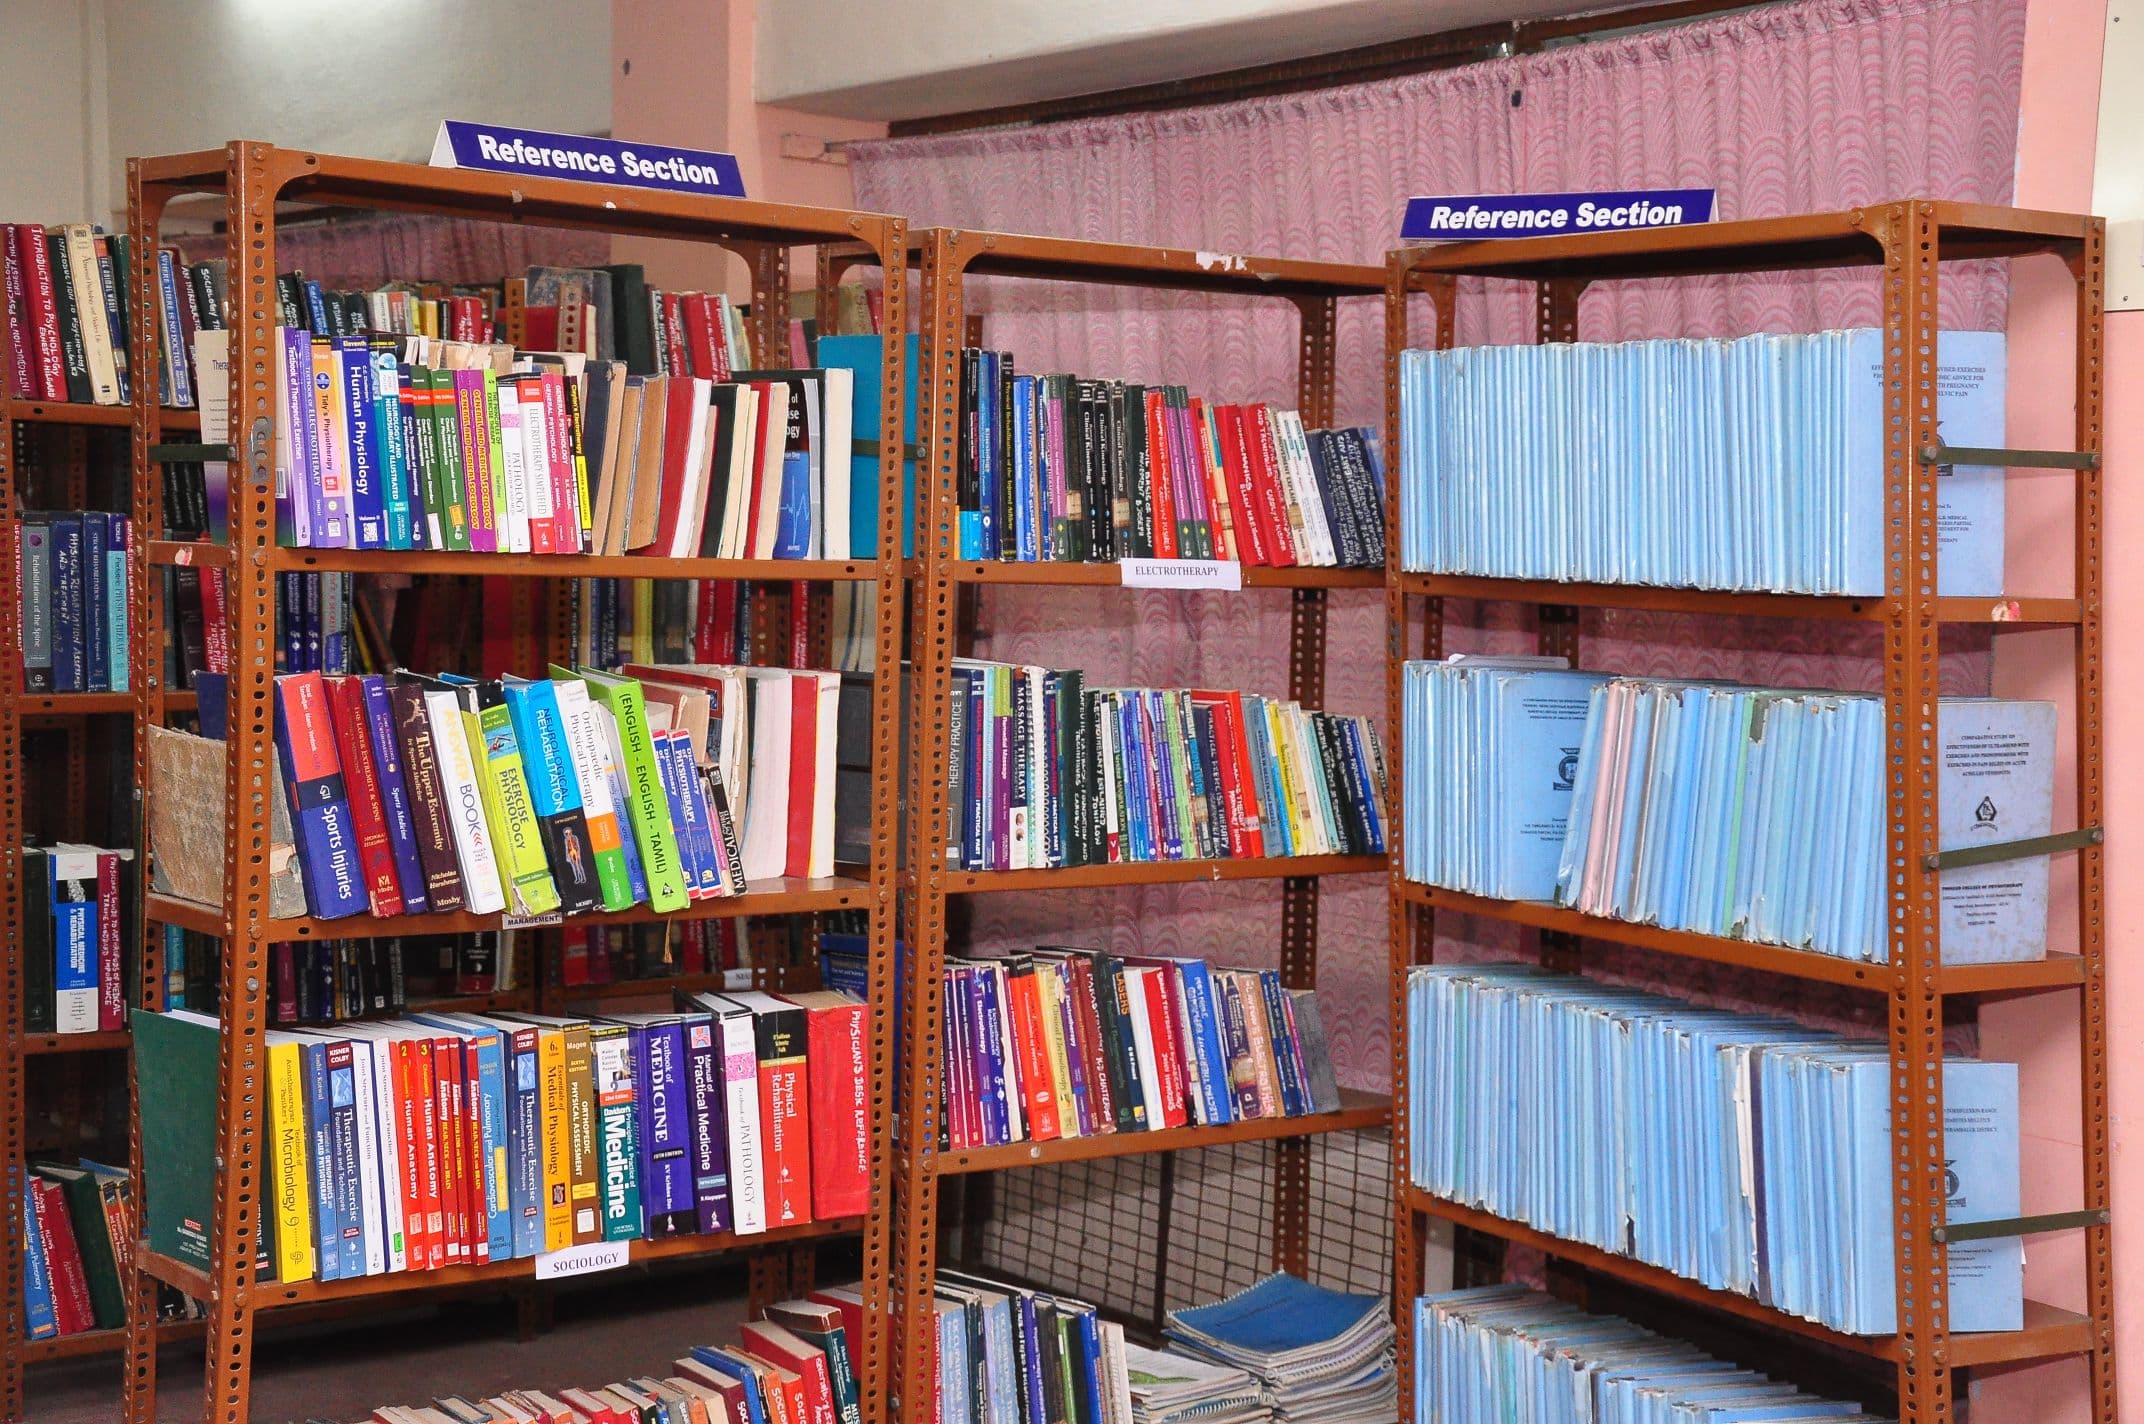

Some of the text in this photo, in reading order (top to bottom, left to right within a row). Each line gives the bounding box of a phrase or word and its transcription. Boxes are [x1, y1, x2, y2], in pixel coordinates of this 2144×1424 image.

[478, 134, 719, 185] Reference Section
[1429, 201, 1682, 229] Reference Section
[31, 228, 60, 376] INTRODUCTION TO PSYCHOLOGY
[58, 238, 75, 300] INTRODUCTION
[70, 304, 76, 313] TO
[160, 254, 181, 367] WHERE THERE DOCTOR
[288, 346, 303, 460] Textbook Therapeutic Exercises
[305, 367, 321, 486] TEXTBOOK ELECTROTHERAPY
[321, 395, 334, 470] Tidy's Physiotherapy
[350, 366, 368, 495] Human Physiology
[391, 398, 400, 441] NEUROLOGY
[555, 385, 569, 464] GENERAL PSYCHOLOGY
[385, 398, 399, 499] NEUROSURGERY ILLUSTRATED
[475, 389, 492, 529] GENERAL AND MEDICAL SOCIOLOGY
[529, 408, 547, 515] ELECTROTHERAPY SIMPLIFIED
[1084, 442, 1093, 484] Kinesiology
[1099, 442, 1107, 485] Kinesiology
[1117, 447, 1125, 492] Kinesiology
[512, 452, 525, 514] PATHOLOGY
[32, 555, 41, 606] Rehabilitation
[1135, 566, 1219, 576] ELECTROTHERAPY
[115, 588, 123, 622] PHYSICAL
[32, 628, 41, 647] Spine
[444, 710, 480, 833] ANSWER BOOK
[535, 709, 564, 812] REHABILITATION
[544, 708, 569, 801] NEUROLOGICAL
[569, 714, 596, 808] Physical Therapy
[582, 711, 604, 782] Orthopaedic
[686, 747, 700, 795] Dictionary
[948, 701, 962, 789] THERAPY PRACTICE
[1017, 686, 1026, 800] MASSAGE THERAPY
[361, 750, 381, 823] EXTREMITY SPINE
[408, 747, 424, 801] Sports Medicine
[415, 732, 445, 851] The Upper Extremity
[508, 768, 529, 824] EXERCISE
[619, 693, 667, 874] (ENGLISH ENGLISH TAMIL)
[675, 749, 696, 823] PHYSIOTHERAPY
[392, 788, 407, 840] Sports Medicine
[499, 770, 526, 849] PHYSIOLOGY
[1218, 808, 1229, 849] THERAPY
[323, 806, 354, 899] Sports Injuries
[723, 834, 744, 889] MEDICAL
[77, 908, 85, 940] PHYSICAL
[437, 897, 461, 907] Mosby
[507, 917, 560, 927] MANAGEMENT
[1115, 972, 1128, 1015] LASERS
[330, 1047, 349, 1056] KISNER
[420, 1044, 429, 1056] 3
[567, 1042, 587, 1050] Magee
[976, 1000, 986, 1054] Electrotherapy
[1052, 1004, 1068, 1091] Clinical Electrotherapy
[315, 1053, 325, 1100] Joshi Kotwal
[331, 1055, 348, 1063] COLBY
[663, 1035, 674, 1083] Textbook of
[704, 1054, 714, 1092] Manual of
[286, 1059, 296, 1123] Ananthanarayan
[439, 1080, 449, 1121] Anatomy
[452, 1083, 461, 1116] Anatomy
[471, 1080, 480, 1121] Anatomy
[650, 1036, 668, 1143] MEDICINE
[693, 1055, 712, 1170] Practical Medicine
[772, 1074, 784, 1152] Rehabilitation
[783, 1072, 796, 1118] Physical
[848, 1010, 867, 1174] PHYSICIAN'S DESK REFERENCE
[334, 1112, 343, 1157] Foundations
[404, 1100, 419, 1200] Human Anatomy
[423, 1098, 438, 1199] Human Anatomy
[525, 1092, 537, 1201] Therapeutic Exercise
[547, 1066, 560, 1176] Medical Physiology
[571, 1082, 582, 1176] PHYSICAL ASSESSMENT
[582, 1101, 590, 1154] ORTHOPEDIC
[625, 1113, 634, 1144] Principles
[282, 1129, 297, 1212] Microbiology
[343, 1109, 359, 1222] Therapeutic Exercise
[484, 1093, 498, 1219] Cardiovascular Pulmonary
[520, 1154, 528, 1191] Techniques
[604, 1116, 627, 1219] Medicine
[627, 1153, 635, 1179] Practice
[629, 1180, 636, 1188] of
[740, 1125, 755, 1205] PATHOLOGY
[337, 1173, 346, 1212] Techniques
[31, 1255, 42, 1290] Pulmonary
[553, 1258, 619, 1272] SOCIOLOGY
